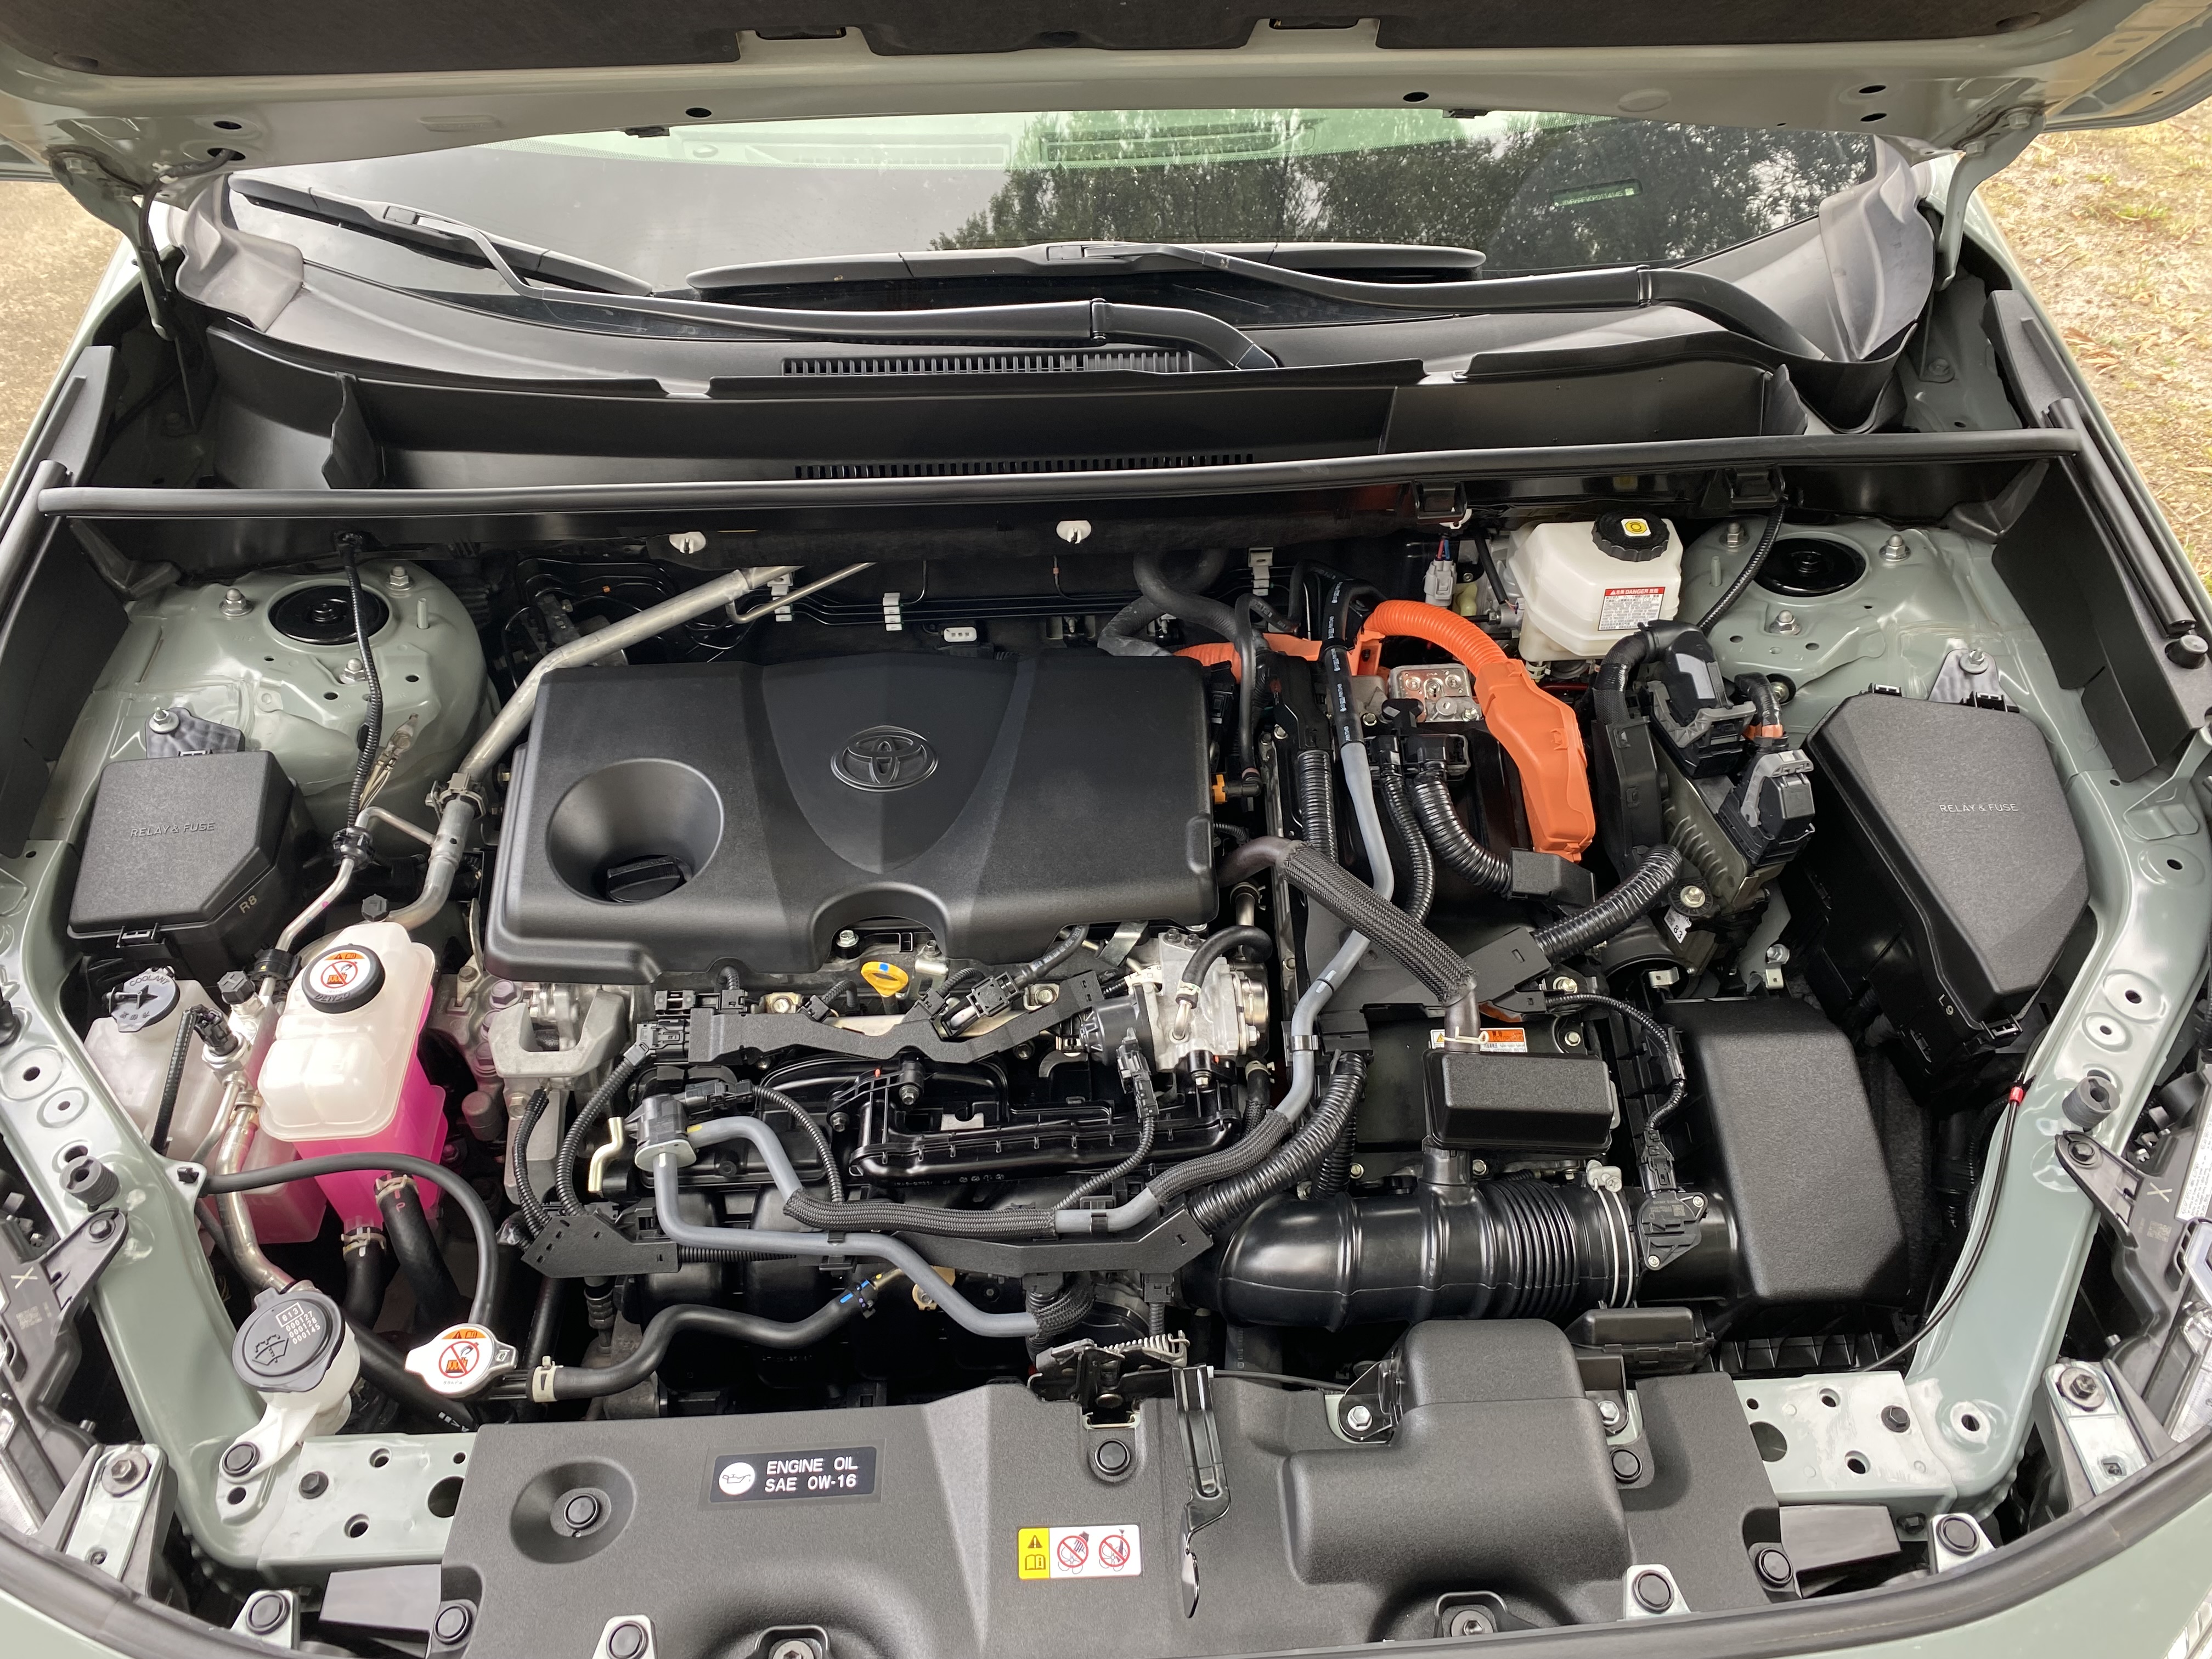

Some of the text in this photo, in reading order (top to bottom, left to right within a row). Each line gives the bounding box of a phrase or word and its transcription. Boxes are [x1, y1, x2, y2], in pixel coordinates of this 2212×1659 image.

[1939, 804, 1975, 813] RELAY
[1988, 803, 2019, 812] FUSE
[130, 822, 216, 838] RELAY & FUSE
[239, 895, 258, 914] R8
[1673, 924, 1683, 939] 83
[129, 975, 170, 986] COOLANT
[314, 991, 351, 1002] DENSO
[286, 1310, 313, 1331] 000127
[289, 1318, 317, 1338] 000128
[292, 1324, 320, 1345] 000145
[766, 1457, 858, 1475] ENGINE OIL
[764, 1474, 857, 1492] SAE 0W-16
